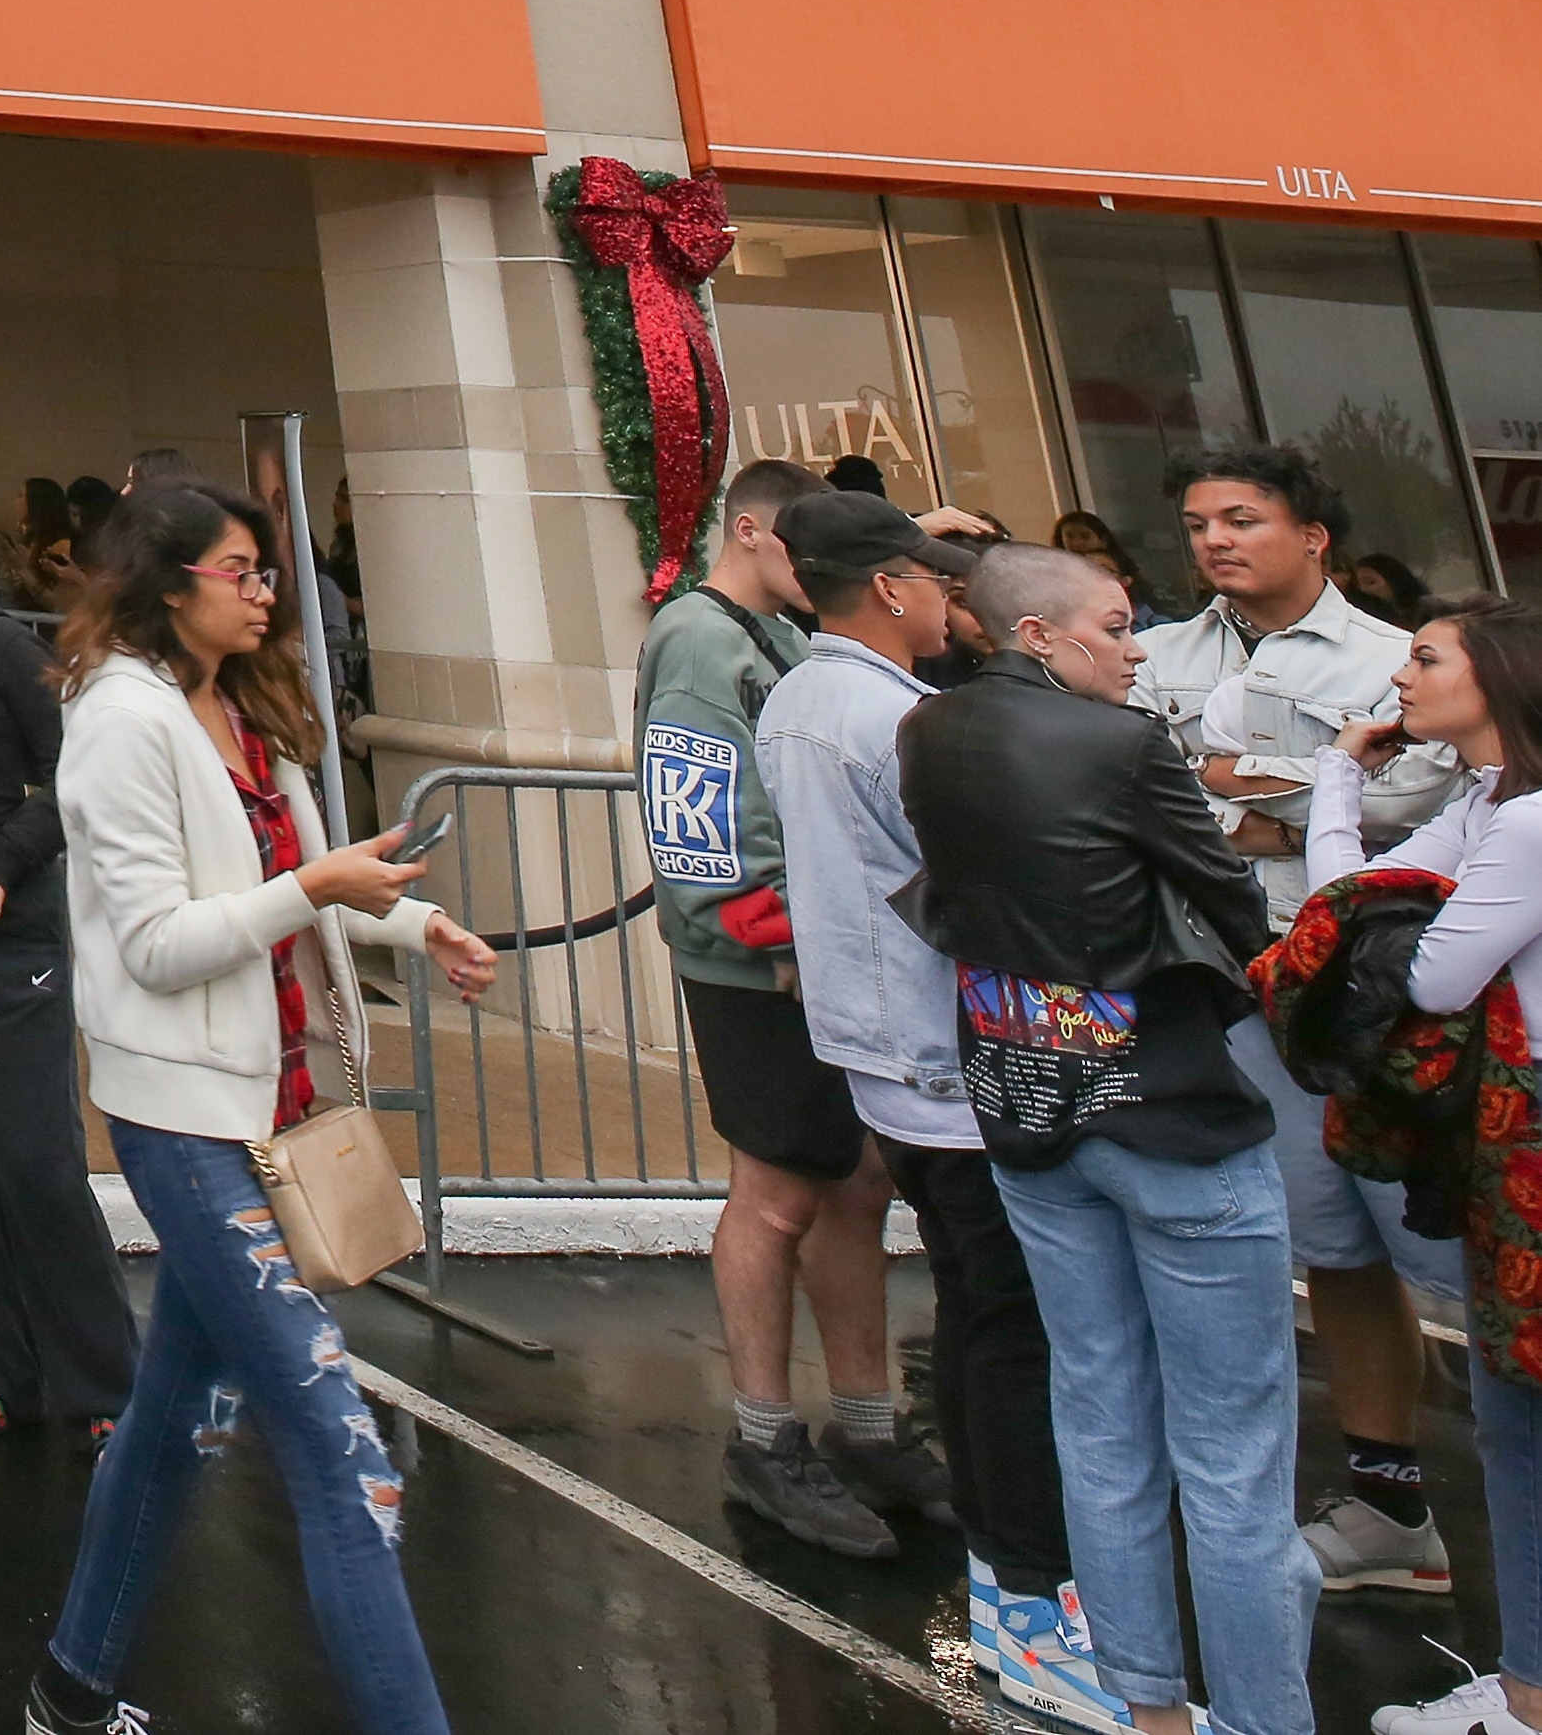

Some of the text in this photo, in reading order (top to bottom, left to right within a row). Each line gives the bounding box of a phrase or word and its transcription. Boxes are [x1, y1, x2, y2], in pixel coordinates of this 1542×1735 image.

[1276, 165, 1357, 202] ULTA
[745, 400, 914, 463] ULTA
[648, 730, 731, 764] KIDS SEE
[654, 849, 734, 877] GHOSTS
